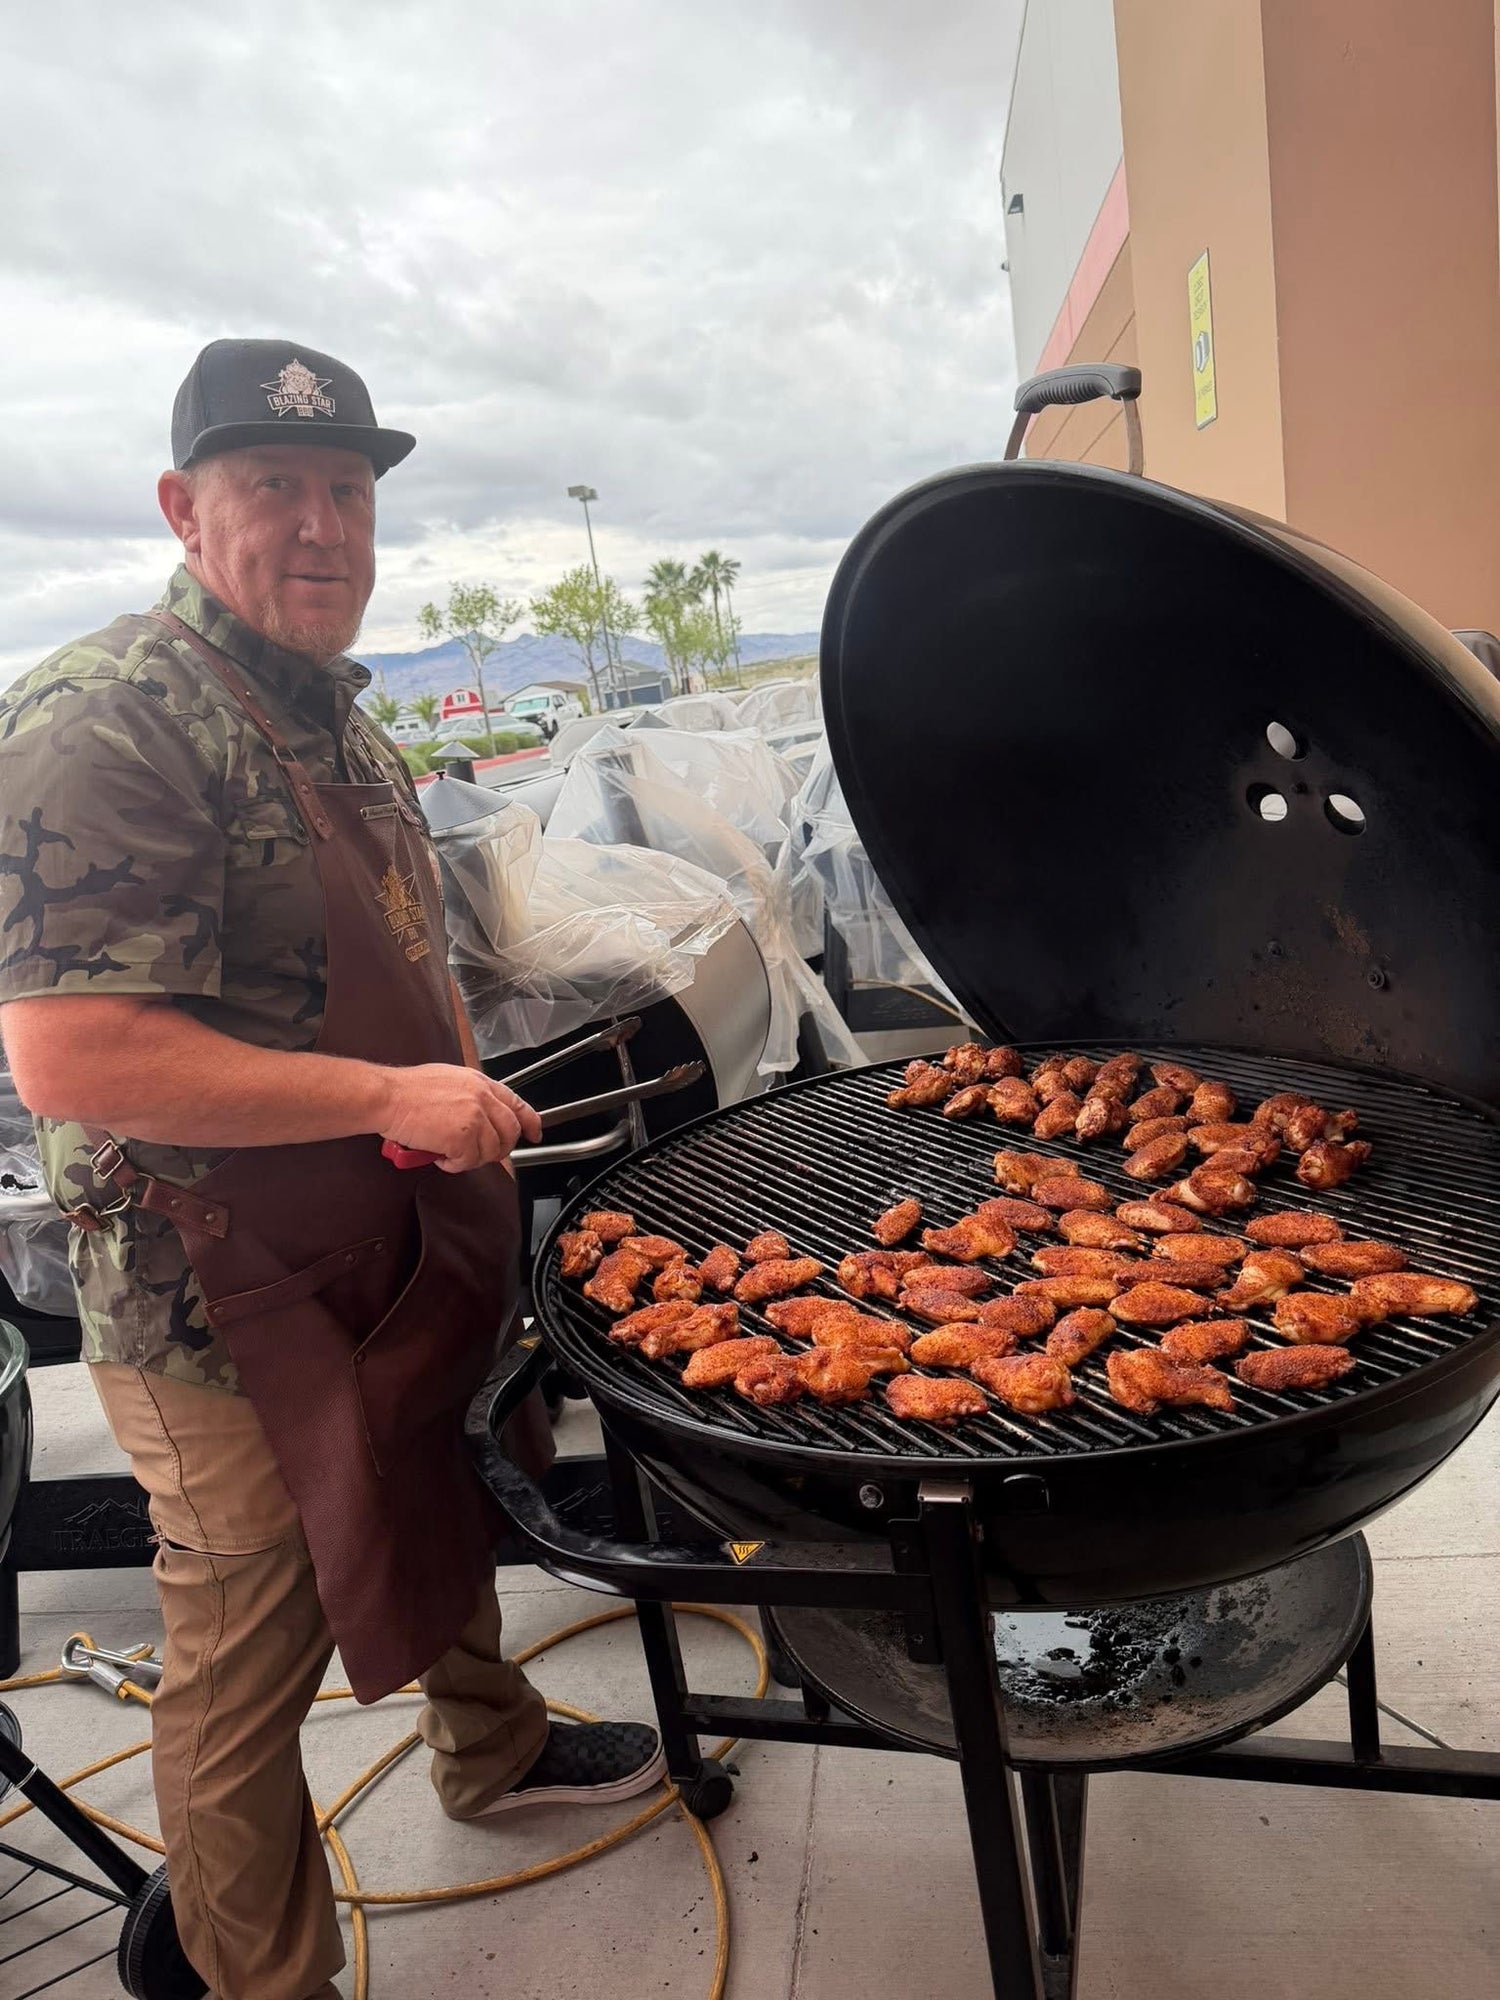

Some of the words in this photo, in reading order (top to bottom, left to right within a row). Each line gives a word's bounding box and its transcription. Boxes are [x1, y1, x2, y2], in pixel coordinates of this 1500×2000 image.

[273, 394, 309, 406] BLAZING
[311, 395, 331, 408] STAR
[53, 1526, 155, 1551] TRAEGE
